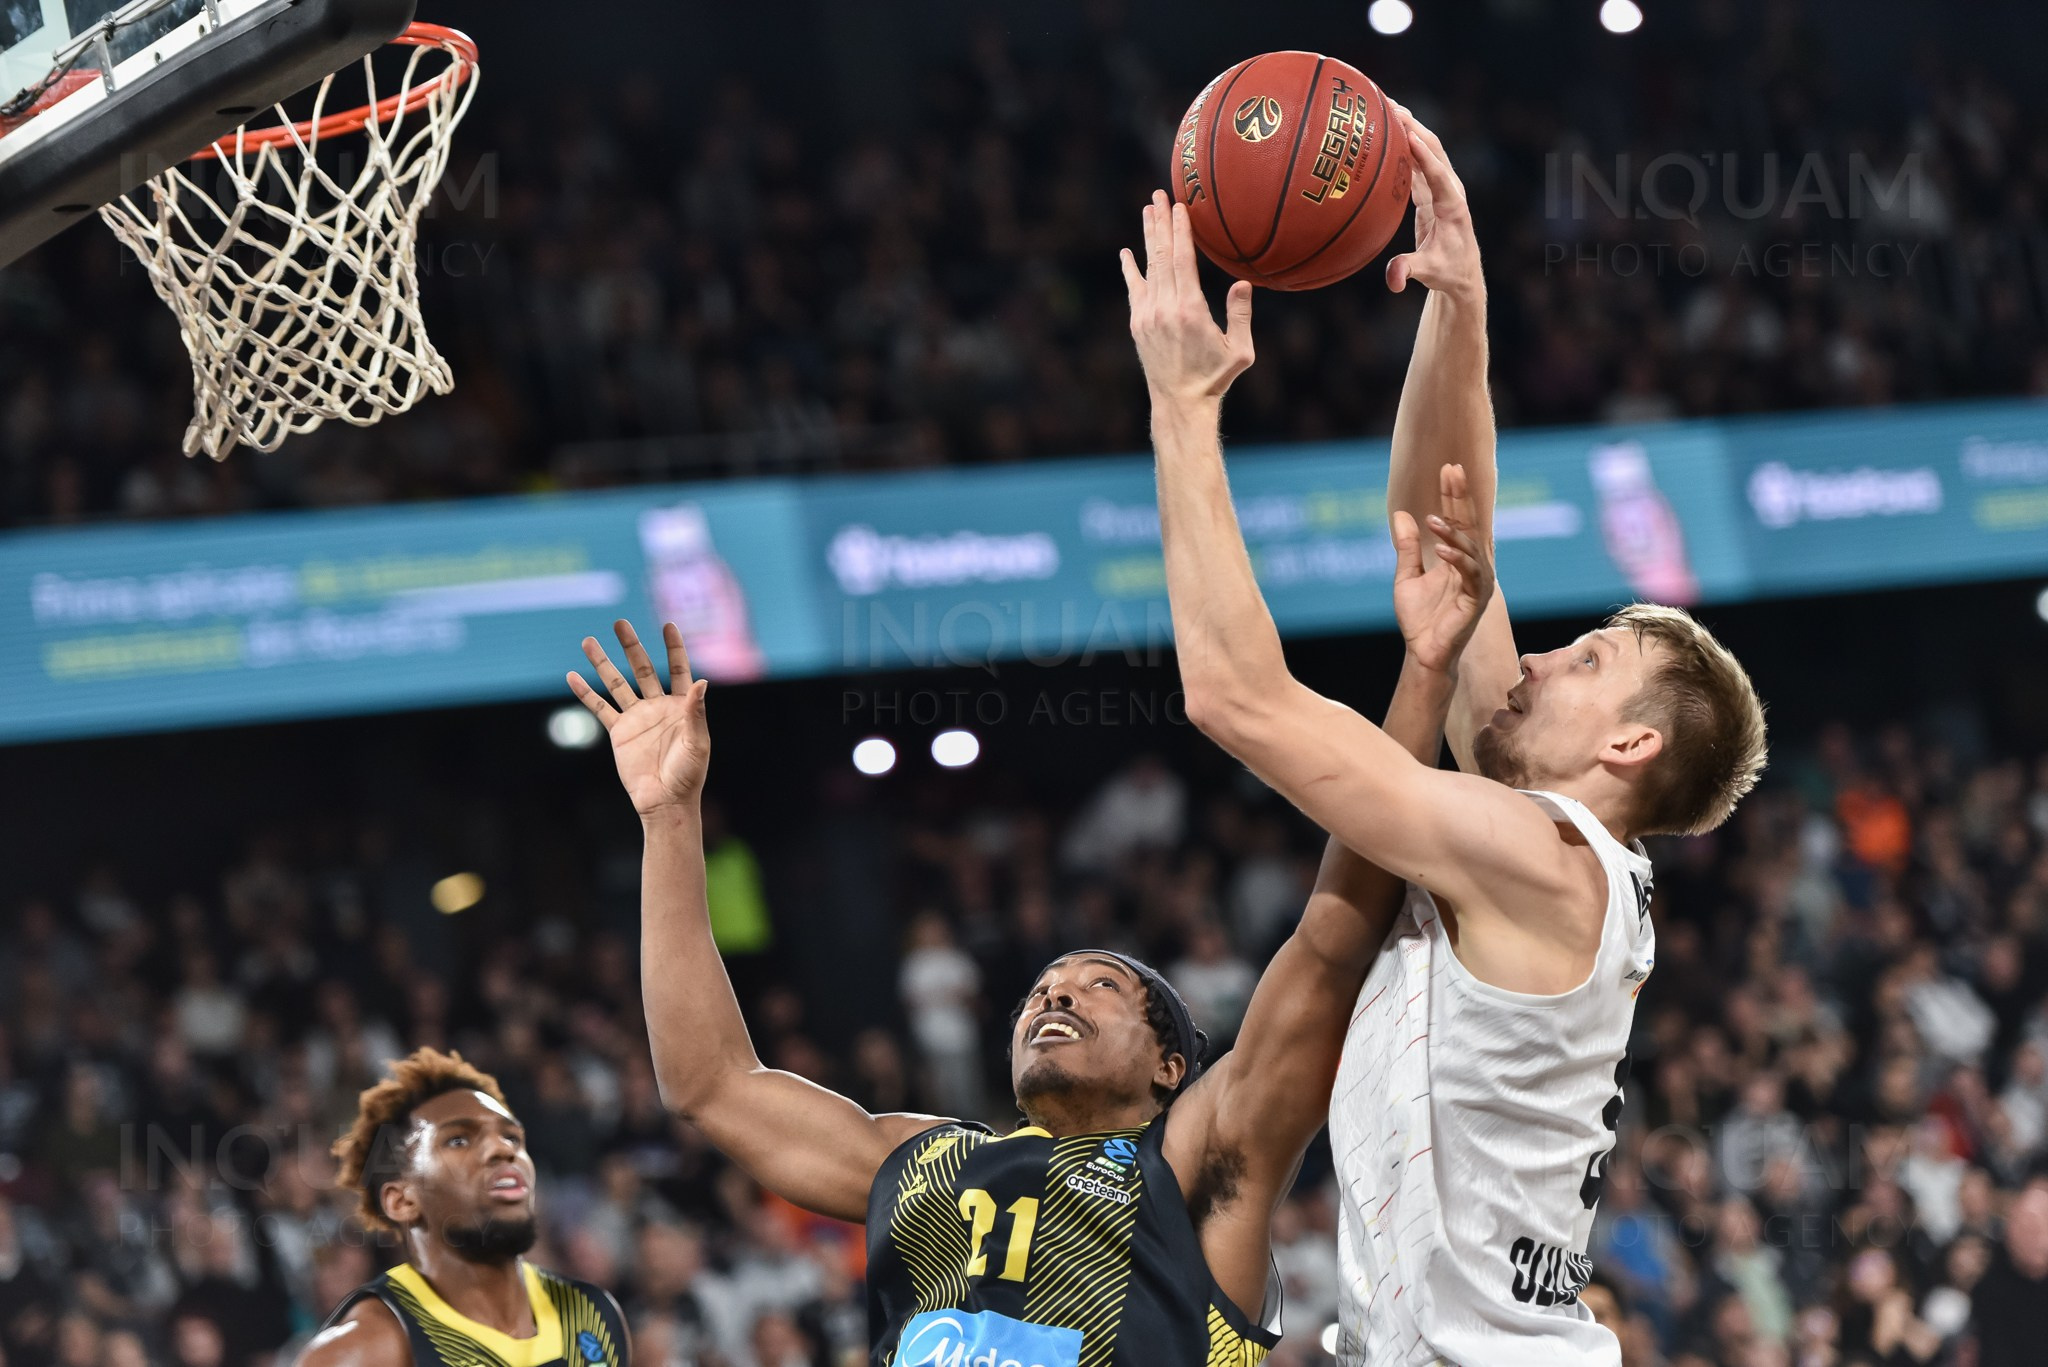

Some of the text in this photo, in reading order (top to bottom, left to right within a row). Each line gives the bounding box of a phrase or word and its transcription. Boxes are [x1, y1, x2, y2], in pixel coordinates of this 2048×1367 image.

[1301, 76, 1354, 205] LEGACY
[1343, 92, 1368, 171] 1000
[1067, 1175, 1132, 1205] oneteam
[1085, 1161, 1125, 1182] EuroCup
[958, 1188, 1039, 1283] 21
